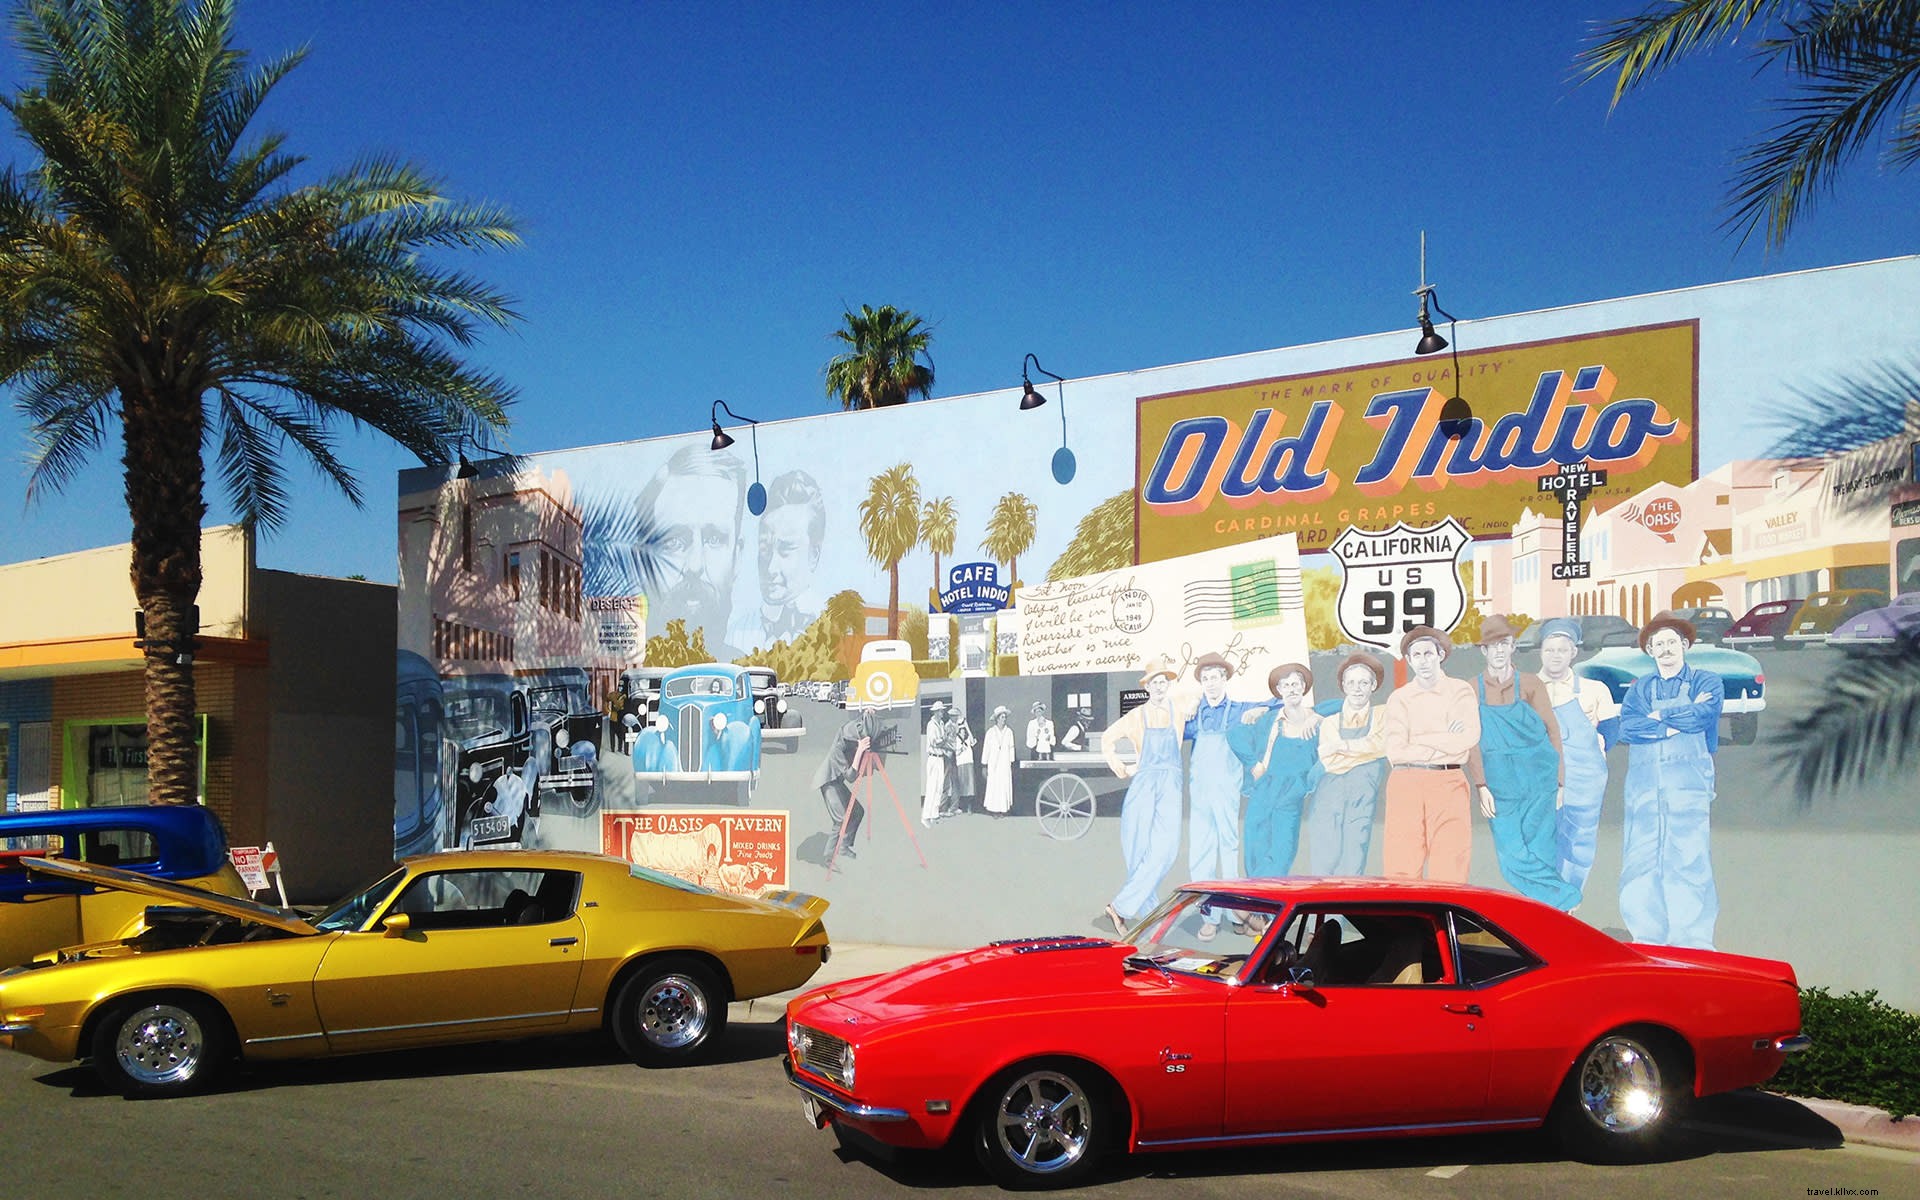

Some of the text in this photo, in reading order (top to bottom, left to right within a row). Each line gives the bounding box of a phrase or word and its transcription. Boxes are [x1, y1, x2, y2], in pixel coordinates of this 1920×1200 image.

[1302, 381, 1354, 396] MARK
[1371, 377, 1391, 389] OF
[1143, 364, 1684, 510] Old Indio
[1560, 463, 1588, 474] NEW
[1541, 472, 1604, 491] HOTEL
[1519, 493, 1553, 502] PROD
[1651, 501, 1673, 511] THE
[1214, 502, 1437, 534] CARDINAL GRAPES
[1482, 520, 1509, 529] INDIO
[1645, 511, 1680, 527] OASIS
[1765, 511, 1799, 529] VALLEY
[1342, 534, 1452, 559] CALIFORNIA
[952, 566, 994, 584] CAFE
[1553, 563, 1588, 578] CAFE
[1059, 581, 1087, 593] Noon
[1067, 575, 1136, 608] beautiful
[941, 586, 1008, 607] HOTEL INDIO
[1120, 590, 1148, 602] INDIO
[591, 598, 635, 611] DESERT
[1362, 587, 1435, 635] 99
[1034, 613, 1066, 629] will
[1088, 608, 1107, 619] in
[1126, 614, 1142, 622] 1949
[1124, 623, 1143, 632] CALIF
[1022, 628, 1084, 647] Riverside
[1024, 638, 1133, 661] weather is nice
[473, 820, 508, 836] 5T5409
[613, 815, 653, 860] THE
[657, 815, 704, 833] OASIS
[720, 817, 783, 862] TAVERN
[732, 841, 781, 850] MIXED DRINKS
[235, 855, 246, 865] NO
[736, 850, 773, 860] Fine Foods
[1166, 1064, 1186, 1073] SS
